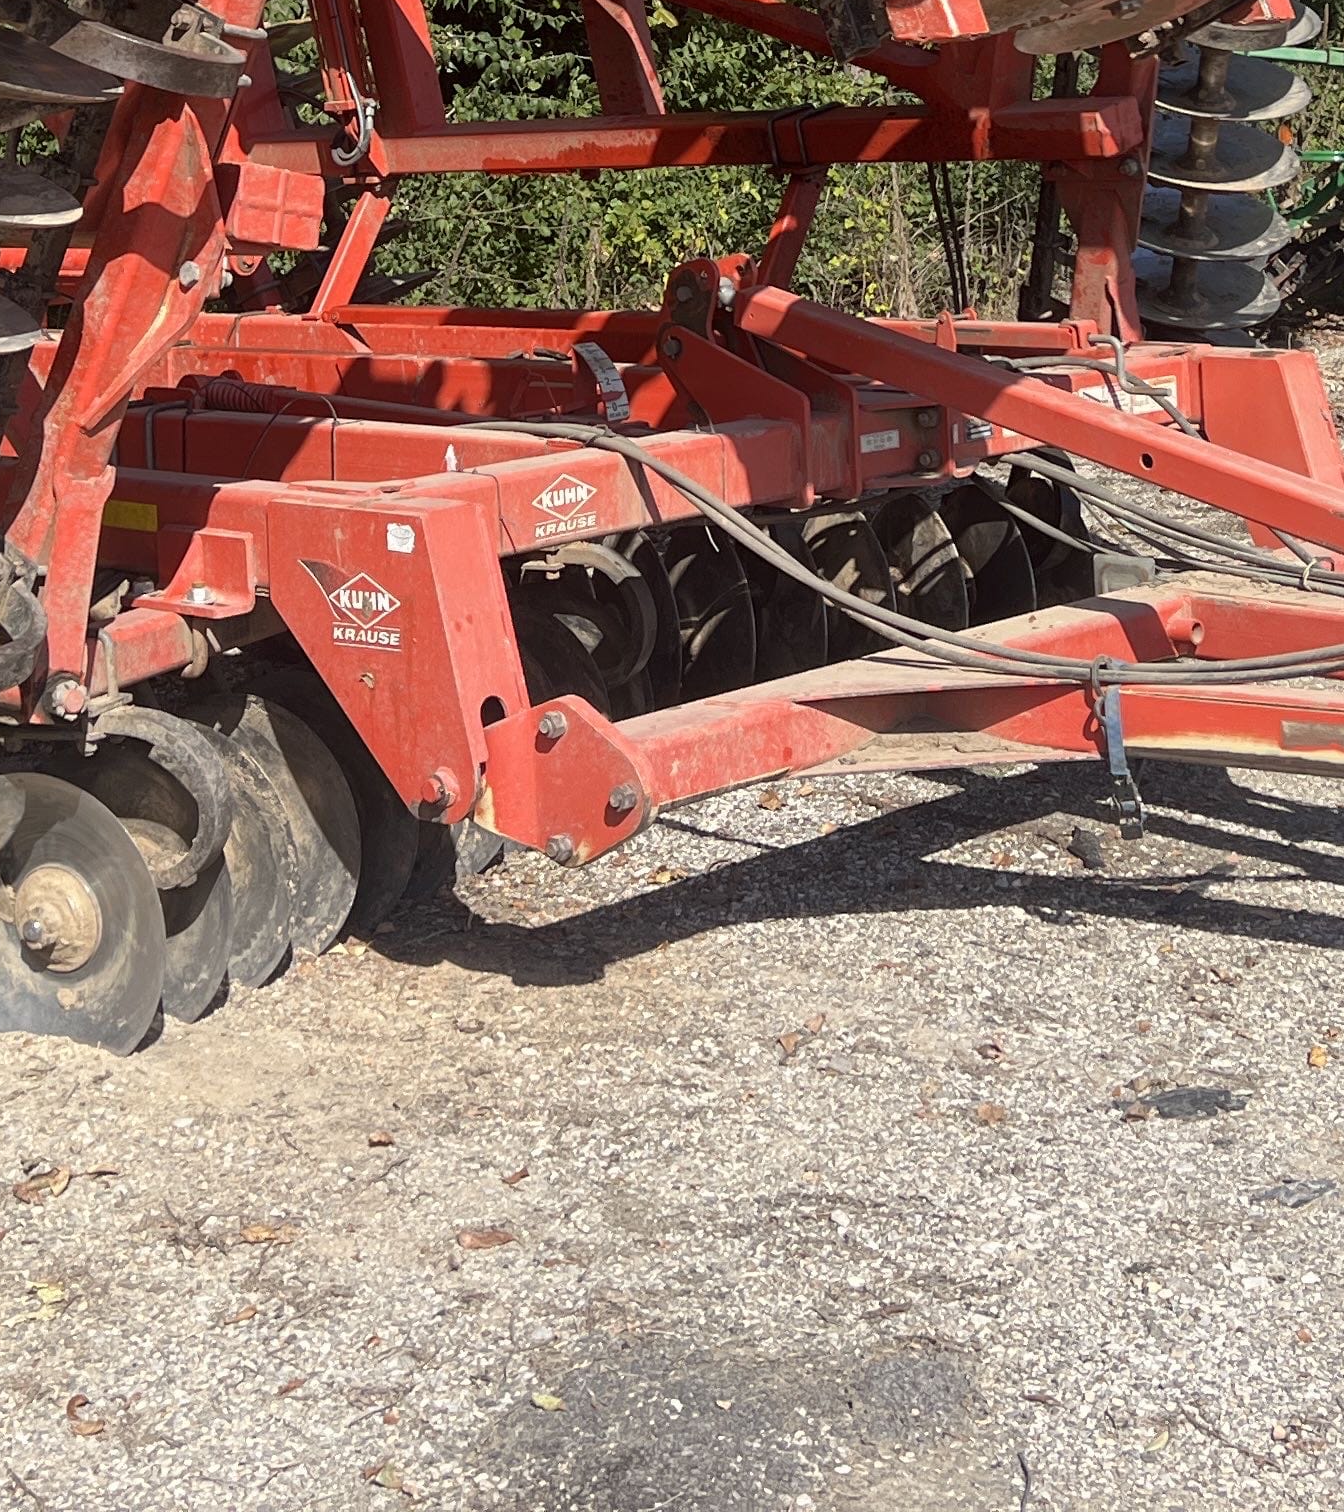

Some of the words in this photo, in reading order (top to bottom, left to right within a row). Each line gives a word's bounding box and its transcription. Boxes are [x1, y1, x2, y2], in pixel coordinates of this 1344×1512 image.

[541, 486, 588, 508] KUHN
[535, 515, 596, 538] KRAUSE
[333, 627, 400, 646] KRAUSE
